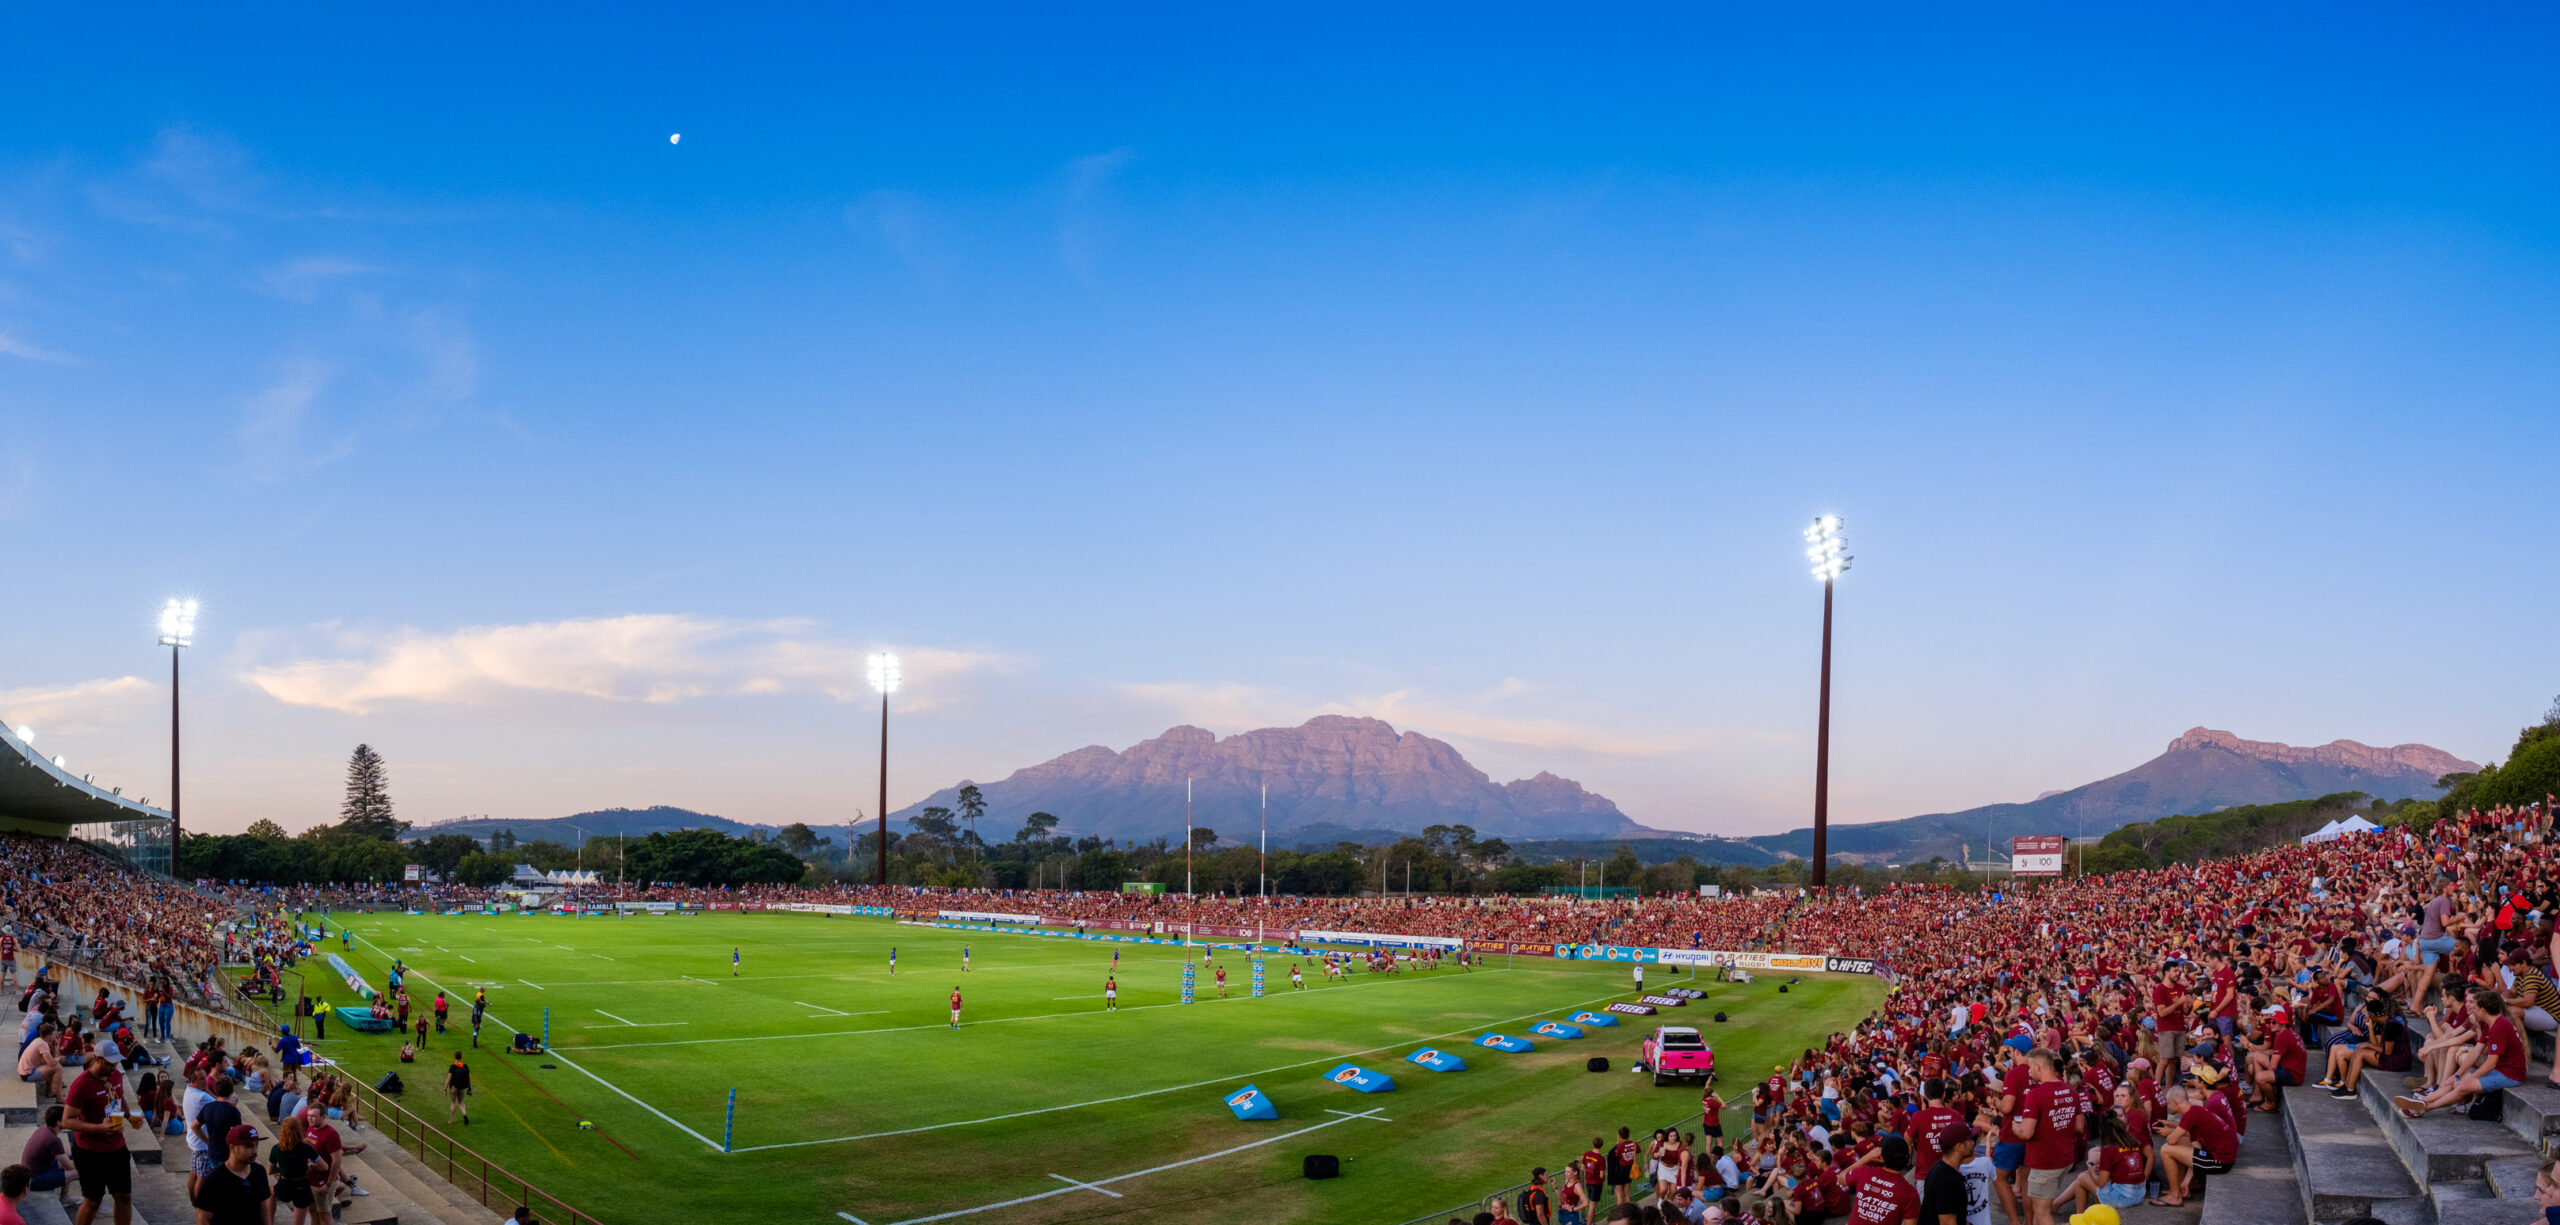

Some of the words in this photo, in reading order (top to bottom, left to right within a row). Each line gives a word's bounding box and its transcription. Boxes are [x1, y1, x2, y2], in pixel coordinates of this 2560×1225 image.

[1240, 929, 1253, 937] 100
[1473, 941, 1505, 950] MATIES
[1519, 944, 1552, 952] MATIES
[1676, 953, 1709, 961] HYUNDAI
[1727, 953, 1767, 961] MATIES
[1838, 960, 1873, 973] HI-TEC
[1642, 995, 1680, 1006] STEERS
[1610, 1003, 1649, 1014] STEERS
[1351, 1076, 1369, 1085] FNB
[2049, 1106, 2076, 1117] MATIES
[2052, 1113, 2075, 1123] SPORT
[2053, 1120, 2071, 1128] RUGBY
[1881, 1189, 1894, 1198] 100
[1857, 1191, 1898, 1211] MATIES
[1858, 1200, 1891, 1216] SPORT
[1858, 1207, 1885, 1221] RUGBY
